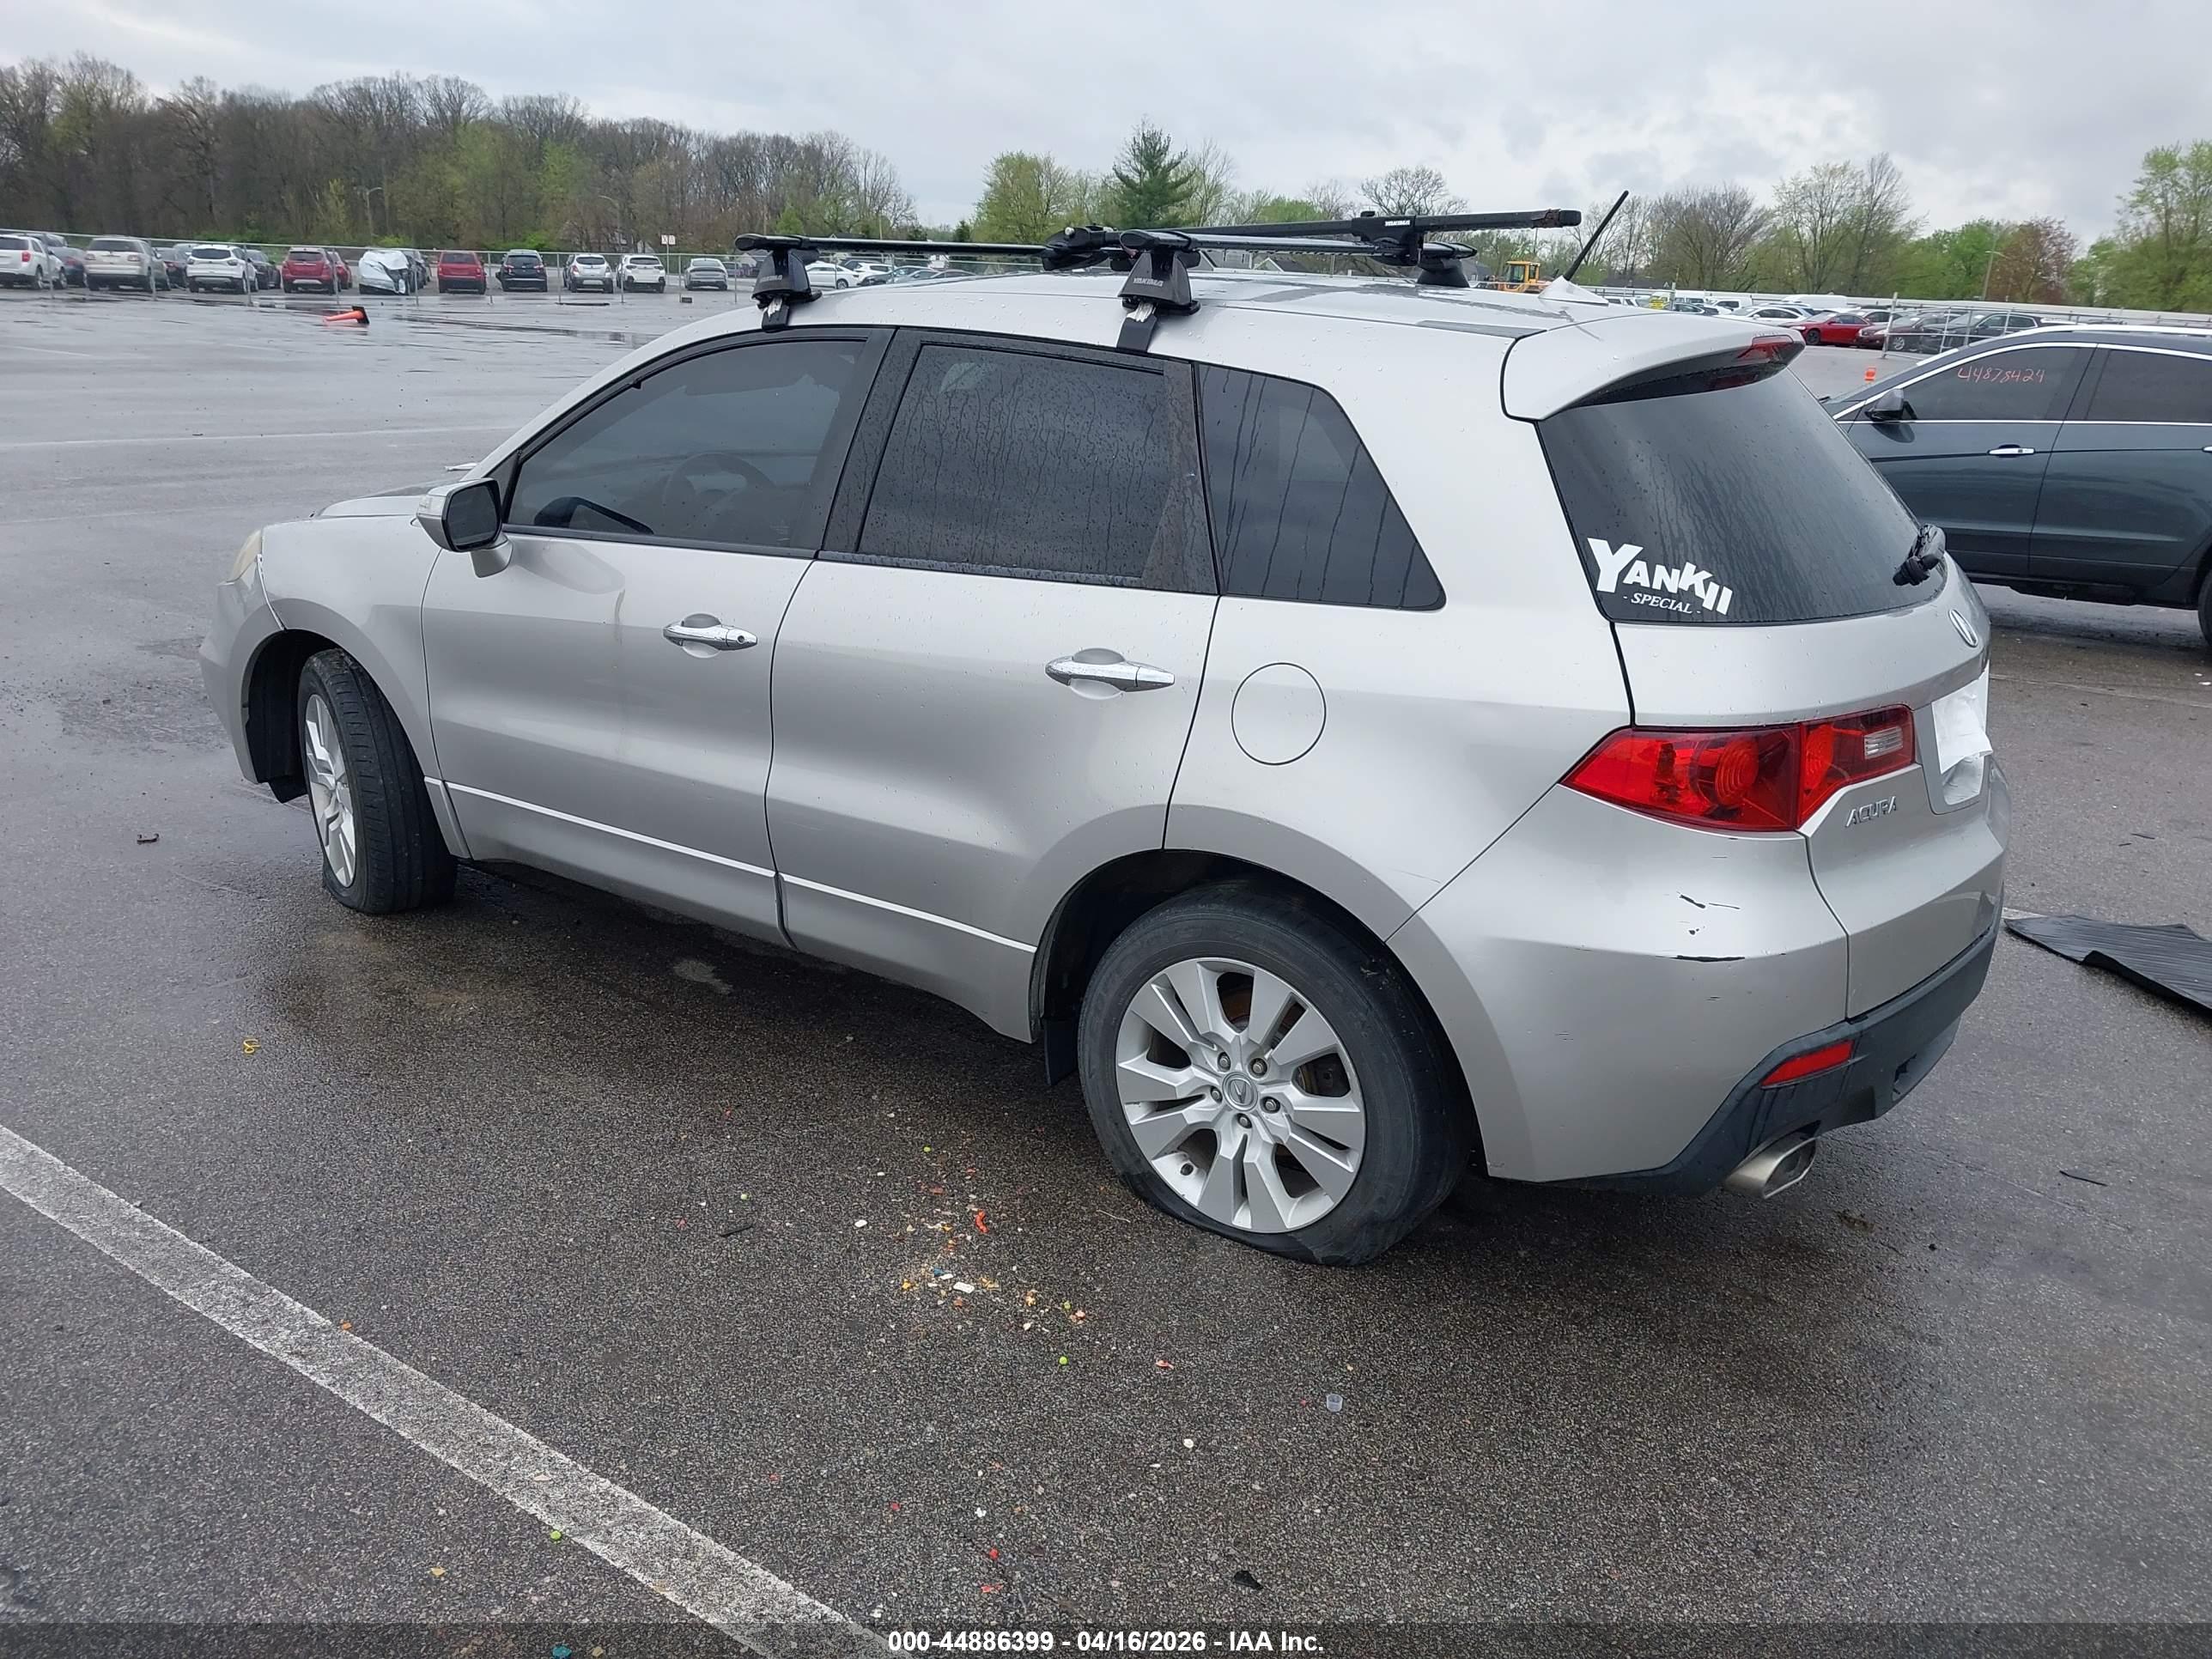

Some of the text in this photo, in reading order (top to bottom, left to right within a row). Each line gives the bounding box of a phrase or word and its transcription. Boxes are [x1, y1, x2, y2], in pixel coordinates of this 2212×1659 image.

[1958, 366, 2045, 383] 44878424
[1631, 592, 1693, 614] SPECIAL
[1845, 796, 1897, 827] ACURA
